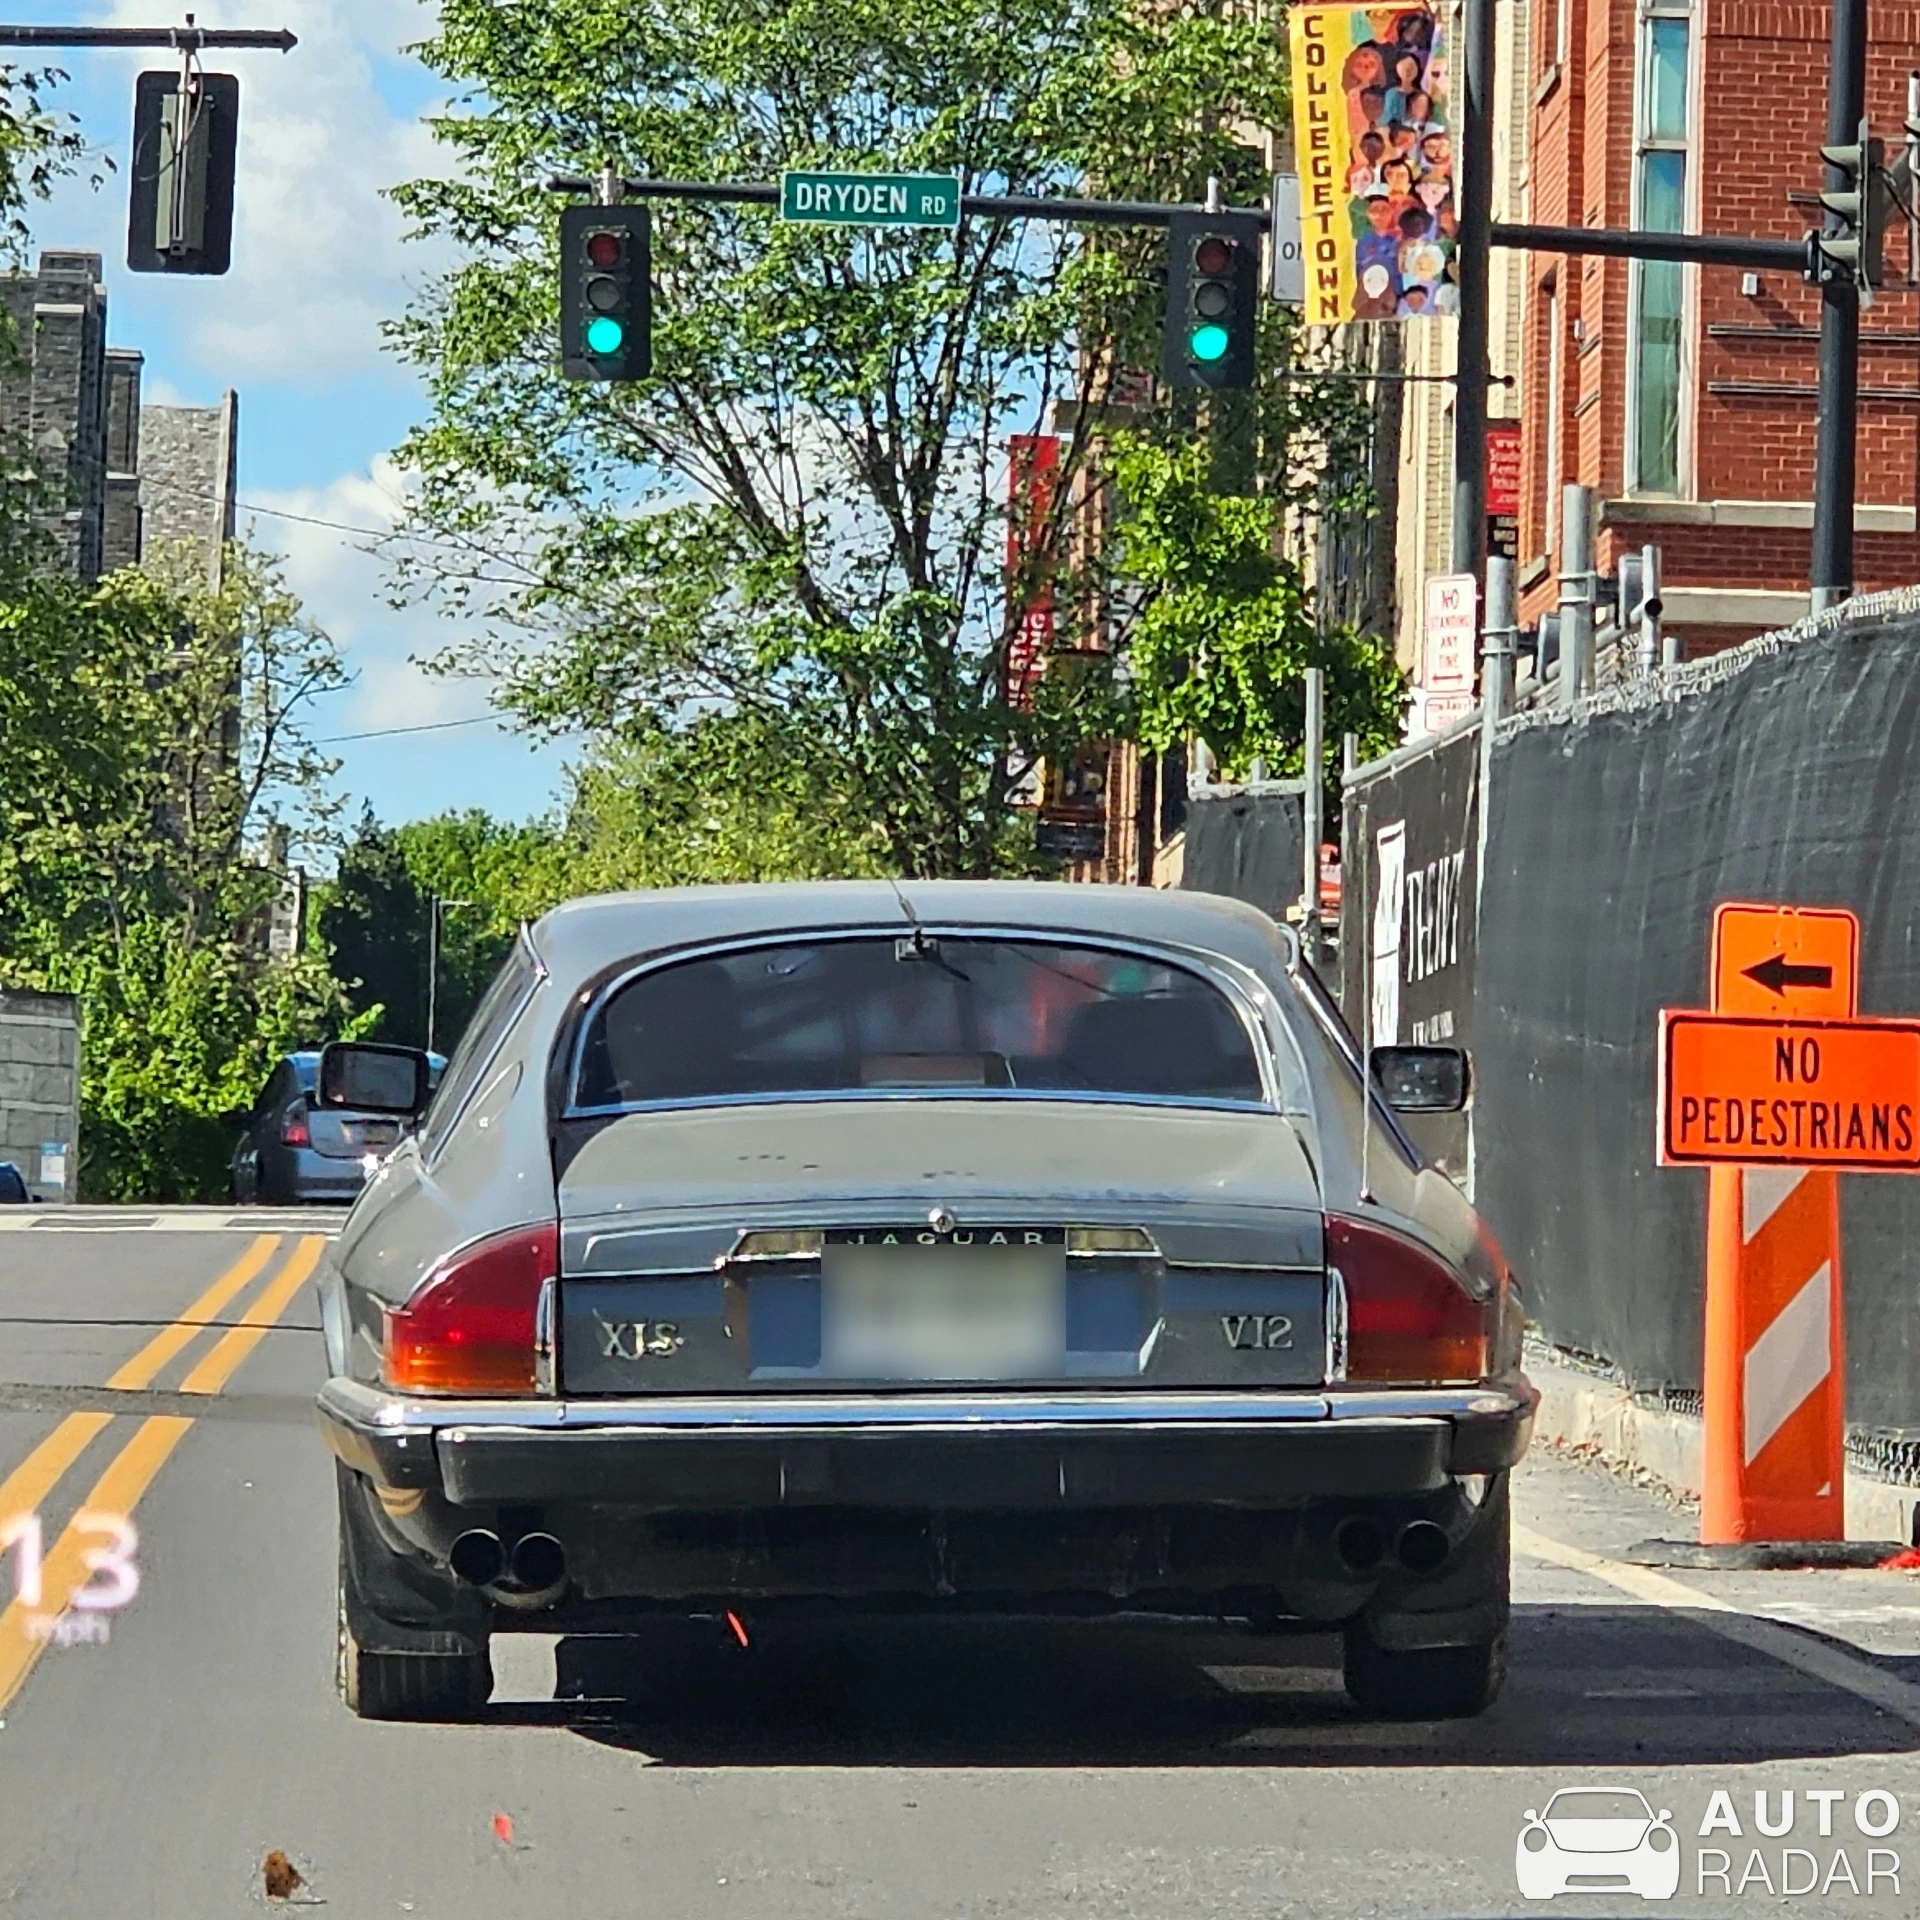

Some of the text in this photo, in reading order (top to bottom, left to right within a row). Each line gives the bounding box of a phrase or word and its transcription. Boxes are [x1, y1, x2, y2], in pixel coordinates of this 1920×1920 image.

[1304, 15, 1340, 319] COLLEGETOWN
[796, 183, 946, 215] DRYDEN RD
[1441, 588, 1459, 610] NO
[1440, 635, 1458, 649] ANY
[1776, 1036, 1820, 1084] NO
[1681, 1096, 1913, 1152] PEDESTRIANS
[846, 1231, 1045, 1245] JAGUAR
[601, 1321, 679, 1360] XJS
[0, 1514, 139, 1609] 13
